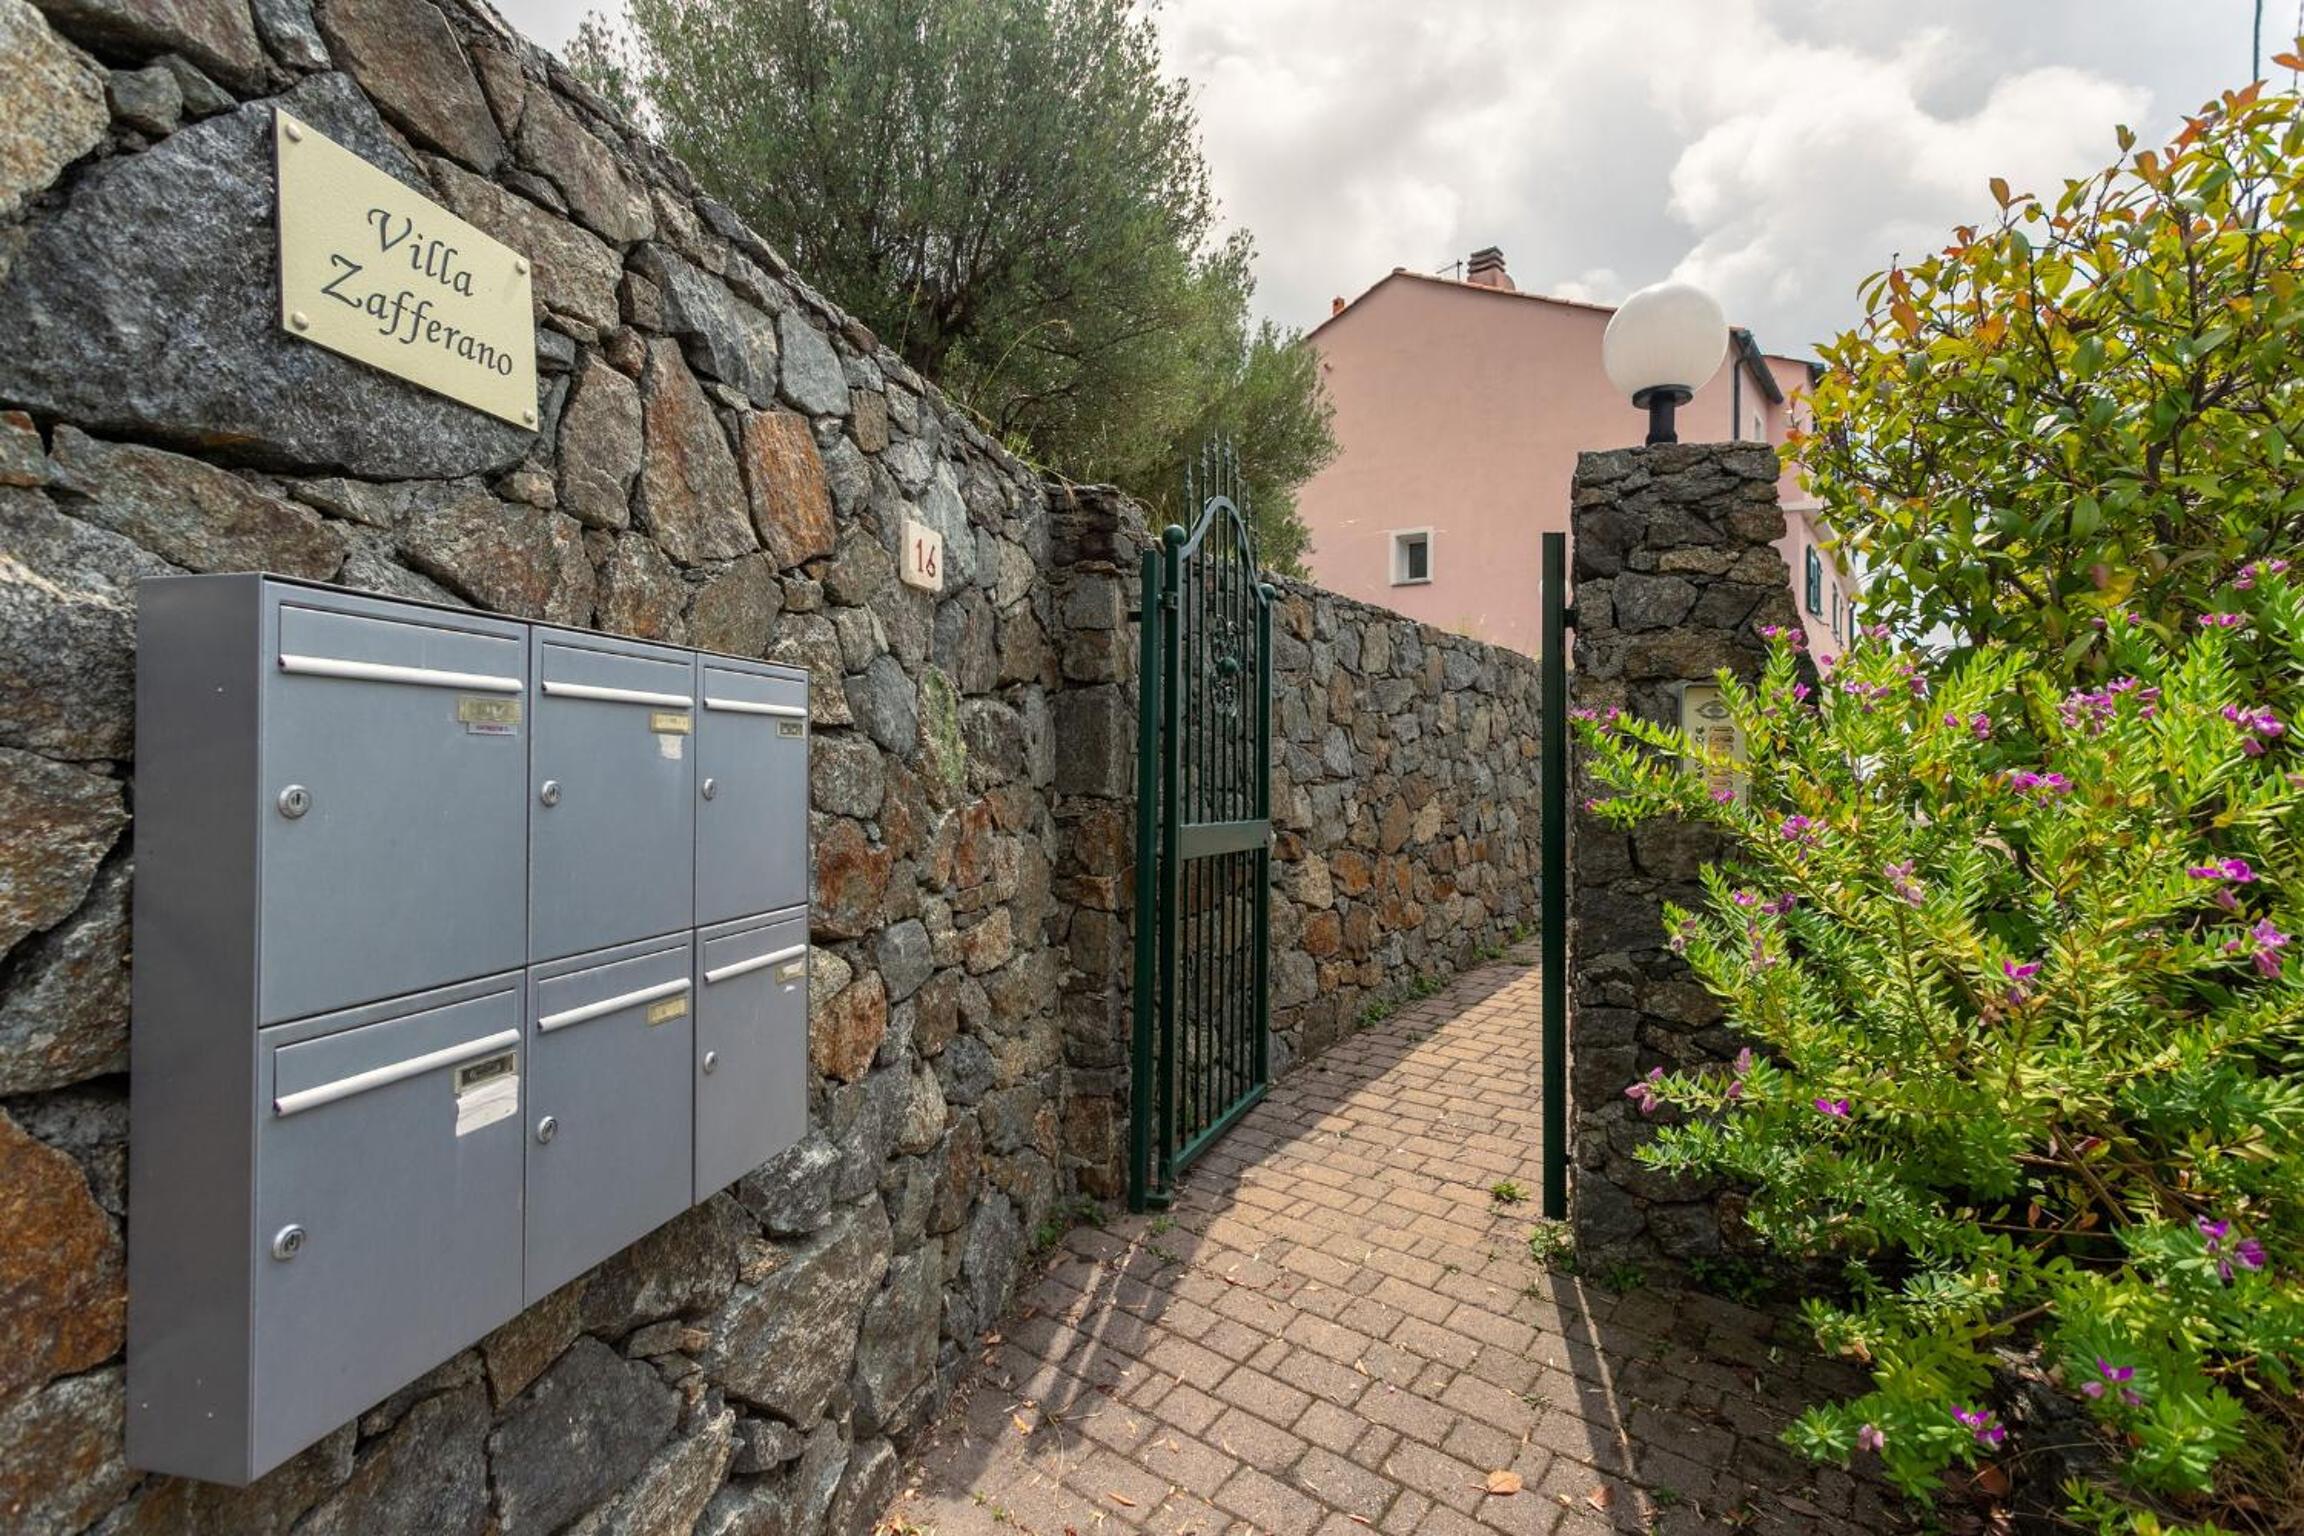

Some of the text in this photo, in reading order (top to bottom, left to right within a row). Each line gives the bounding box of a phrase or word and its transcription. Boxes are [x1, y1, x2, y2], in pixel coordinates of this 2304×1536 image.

[367, 208, 474, 297] Villa
[320, 253, 512, 376] Zafferano
[916, 538, 936, 578] 16
